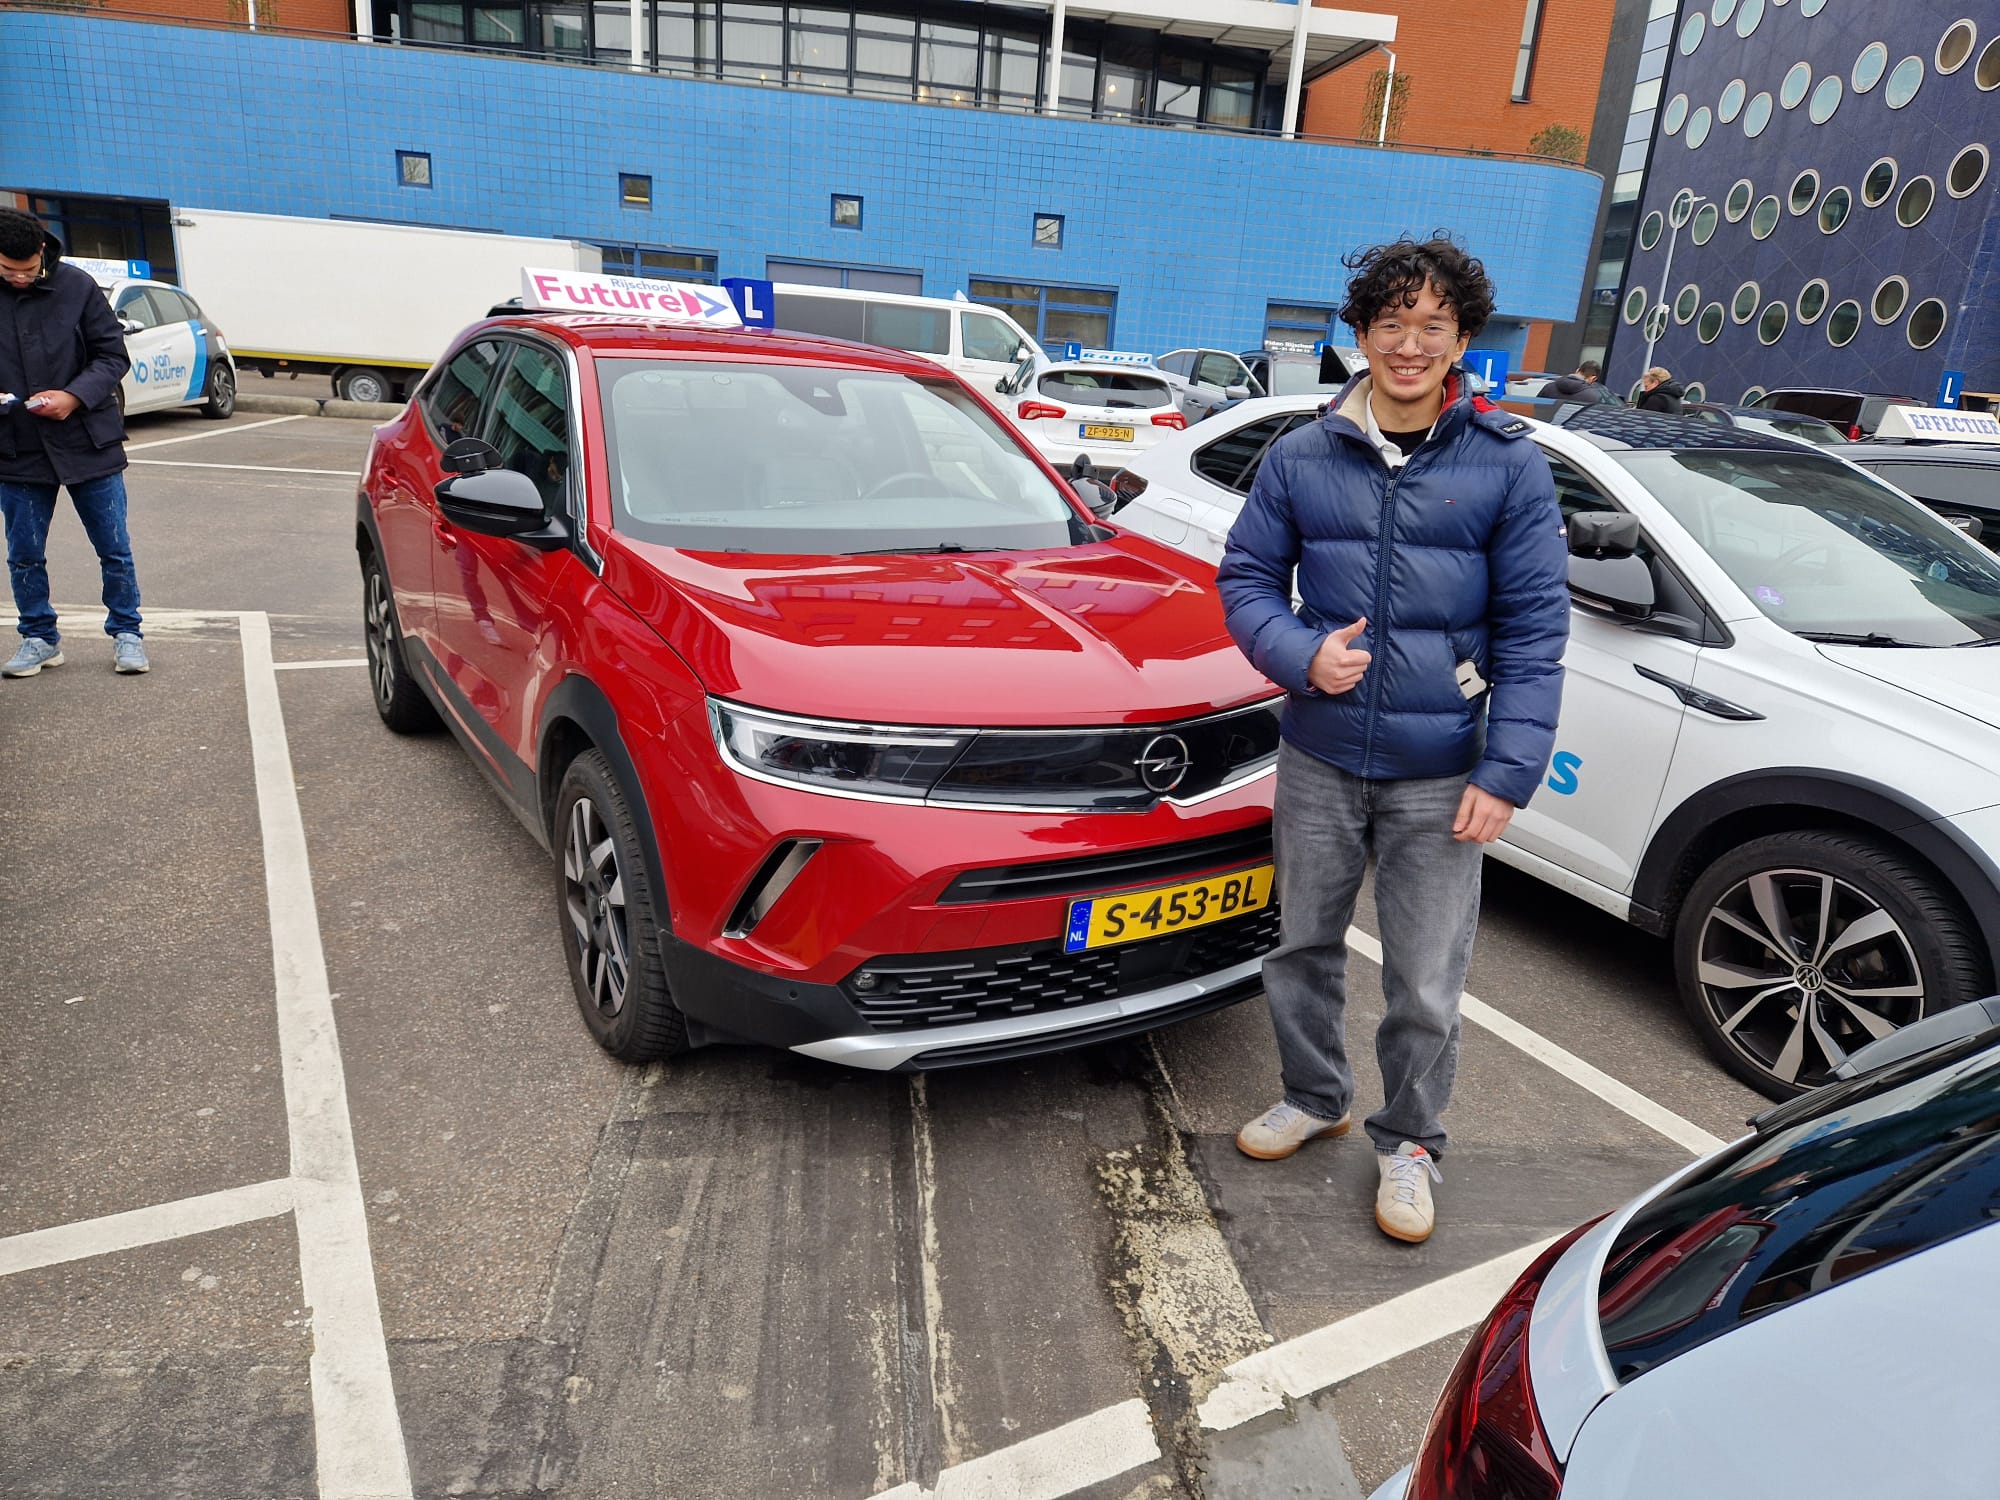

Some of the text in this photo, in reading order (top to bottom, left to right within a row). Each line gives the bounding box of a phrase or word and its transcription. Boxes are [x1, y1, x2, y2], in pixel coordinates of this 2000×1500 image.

[132, 262, 142, 275] L
[610, 278, 673, 293] Rijschool
[533, 274, 682, 314] Future
[744, 286, 764, 319] L
[1068, 345, 1076, 358] L
[1083, 352, 1150, 363] Rapid
[152, 354, 171, 368] van
[153, 366, 187, 381] buuren
[1484, 358, 1498, 388] L
[1944, 377, 1954, 404] L
[1908, 409, 2000, 435] EFFECTIEF
[1087, 426, 1131, 439] ZF-925-N
[1103, 875, 1258, 938] S-453-BL
[1069, 930, 1085, 943] NL
